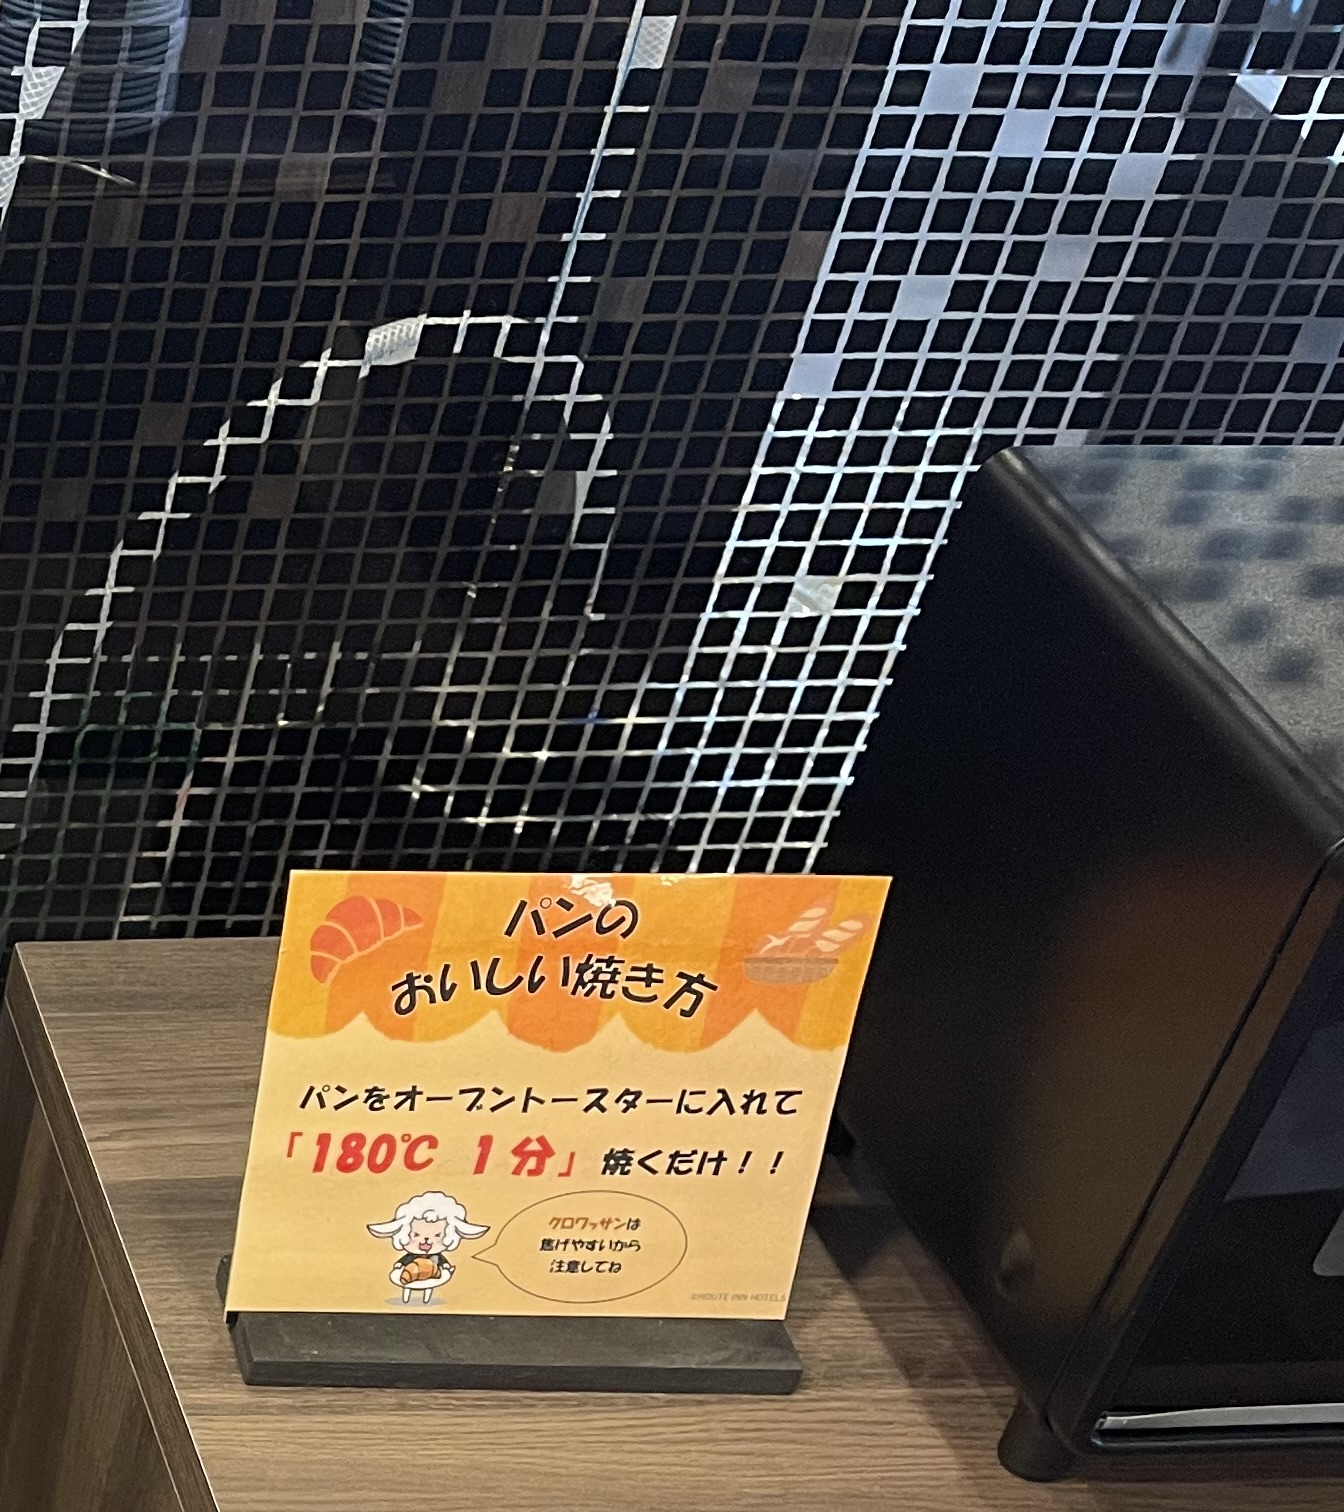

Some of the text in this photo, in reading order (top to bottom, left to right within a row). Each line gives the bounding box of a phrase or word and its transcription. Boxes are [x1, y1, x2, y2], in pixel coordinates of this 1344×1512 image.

[504, 897, 639, 939] パンの
[391, 953, 718, 1018] おいしい焼き方
[298, 1084, 803, 1117] パンをオーブントースターに入れて
[548, 1217, 642, 1230] クロワッサンは
[539, 1238, 642, 1252] 焦げやすいから
[549, 1260, 622, 1274] 注意してね
